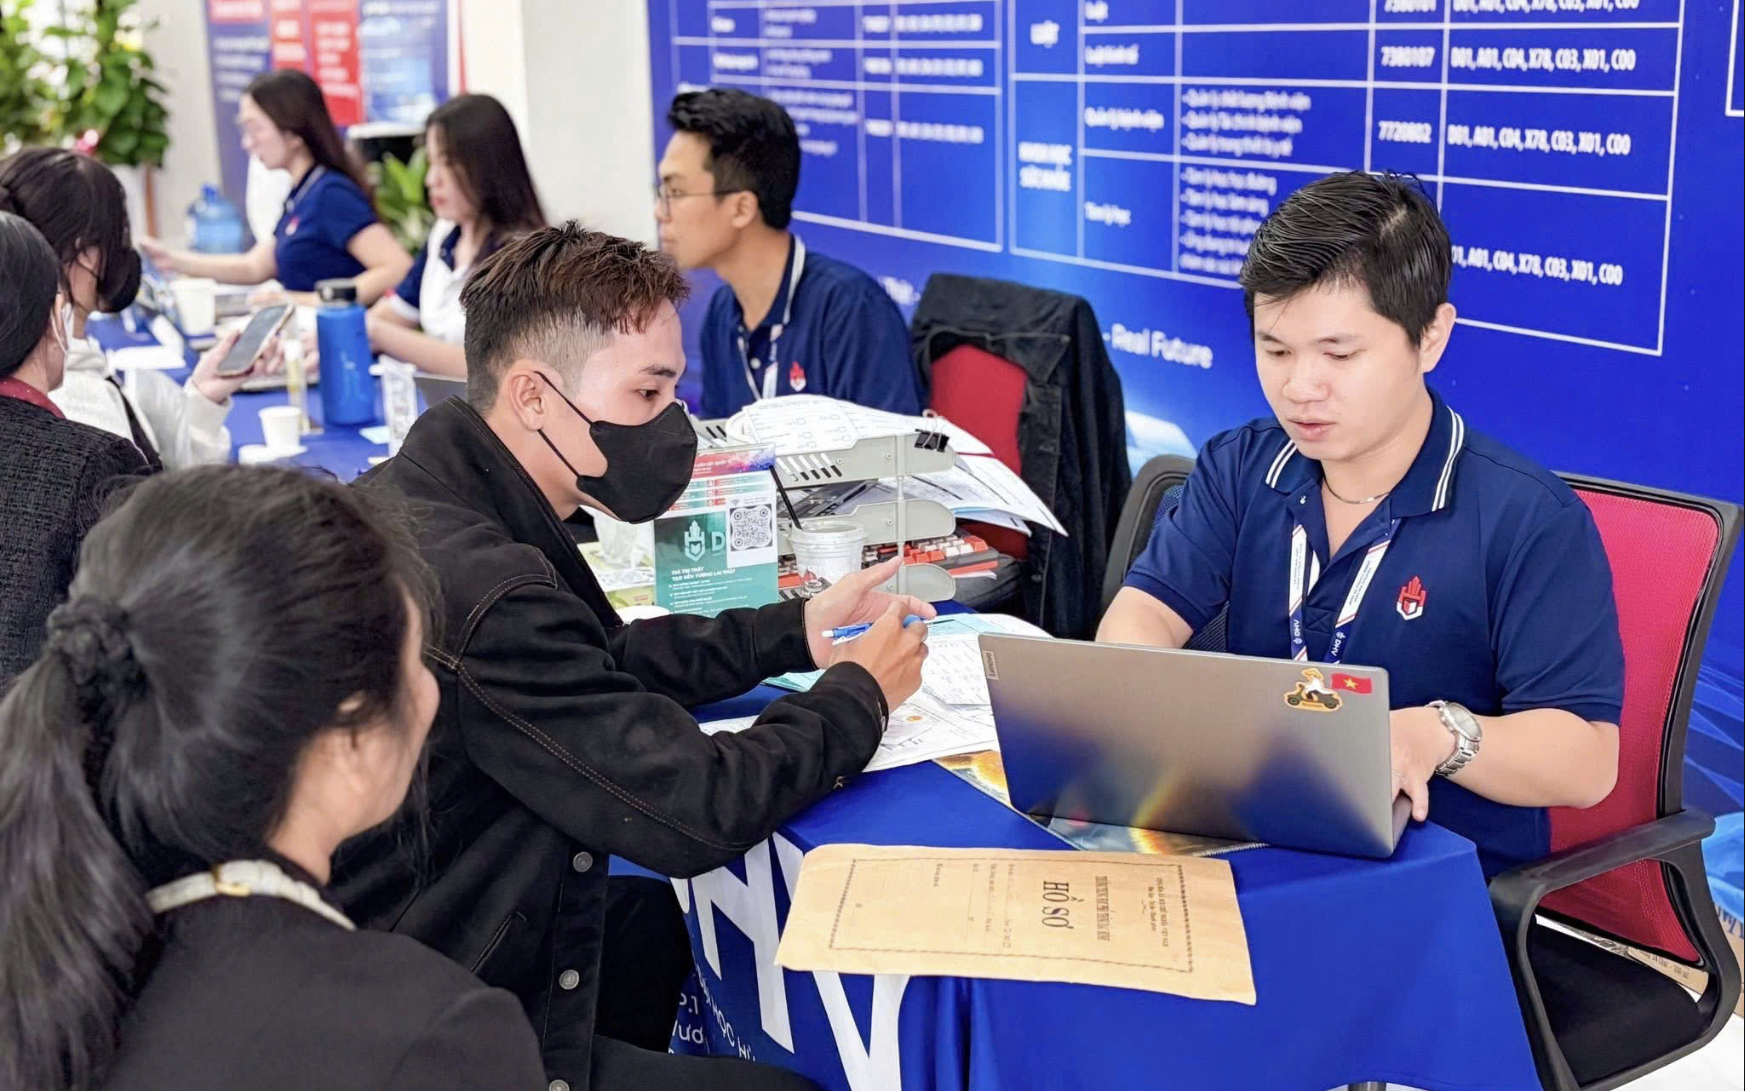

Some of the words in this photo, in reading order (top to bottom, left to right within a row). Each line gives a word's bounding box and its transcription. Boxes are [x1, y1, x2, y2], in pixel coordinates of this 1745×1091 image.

[1555, 48, 1581, 72] C03,
[1582, 49, 1609, 73] X01,
[1611, 49, 1636, 71] C00
[1551, 130, 1577, 155] C03,
[1578, 132, 1604, 157] X01,
[1606, 133, 1631, 155] C00
[1492, 250, 1517, 275] C04,
[1518, 252, 1543, 278] X78,
[1544, 256, 1570, 282] C03,
[1571, 259, 1597, 286] X01,
[1599, 263, 1623, 286] C00
[1112, 324, 1149, 354] Real
[1152, 331, 1213, 369] Future
[1331, 638, 1342, 657] DHV
[986, 652, 996, 677] Lenovo
[1041, 879, 1086, 903] HỒ
[1040, 903, 1075, 931] SƠ
